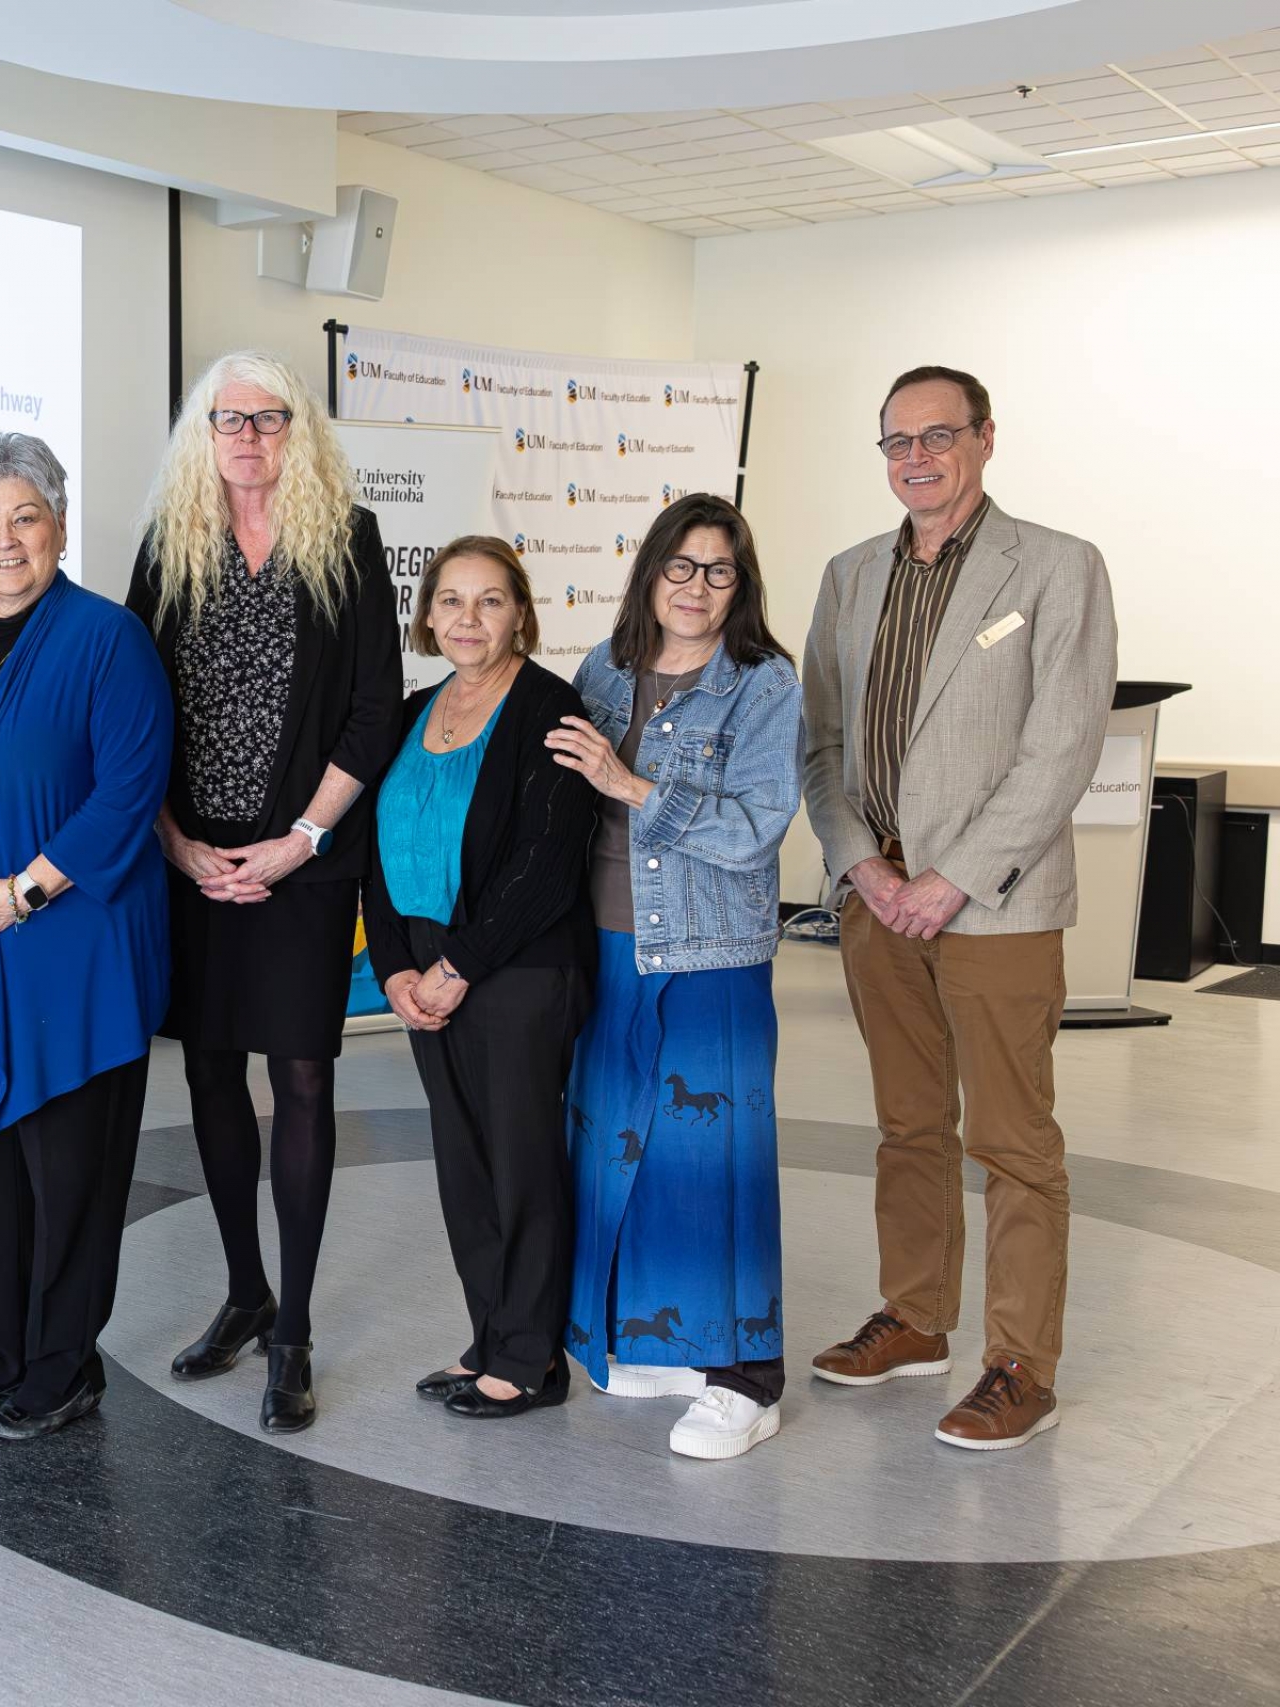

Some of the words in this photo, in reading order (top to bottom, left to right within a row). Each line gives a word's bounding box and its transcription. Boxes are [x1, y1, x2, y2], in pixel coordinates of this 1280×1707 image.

[361, 361, 382, 379] UM
[384, 369, 407, 384] Faculty
[408, 371, 415, 383] of
[415, 373, 446, 386] Education
[474, 375, 493, 392] UM
[579, 385, 596, 400] UM
[674, 390, 690, 404] UM
[527, 434, 545, 449] UM
[628, 438, 644, 453] UM
[356, 468, 426, 489] University
[362, 486, 424, 503] Manitoba
[495, 490, 517, 502] Faculty
[518, 491, 525, 500] of
[524, 492, 553, 502] Education
[578, 488, 596, 503] UM
[527, 539, 545, 553] UM
[548, 544, 569, 554] Faculty
[575, 544, 602, 553] Education
[577, 590, 594, 604] UM
[1089, 781, 1141, 794] Education
